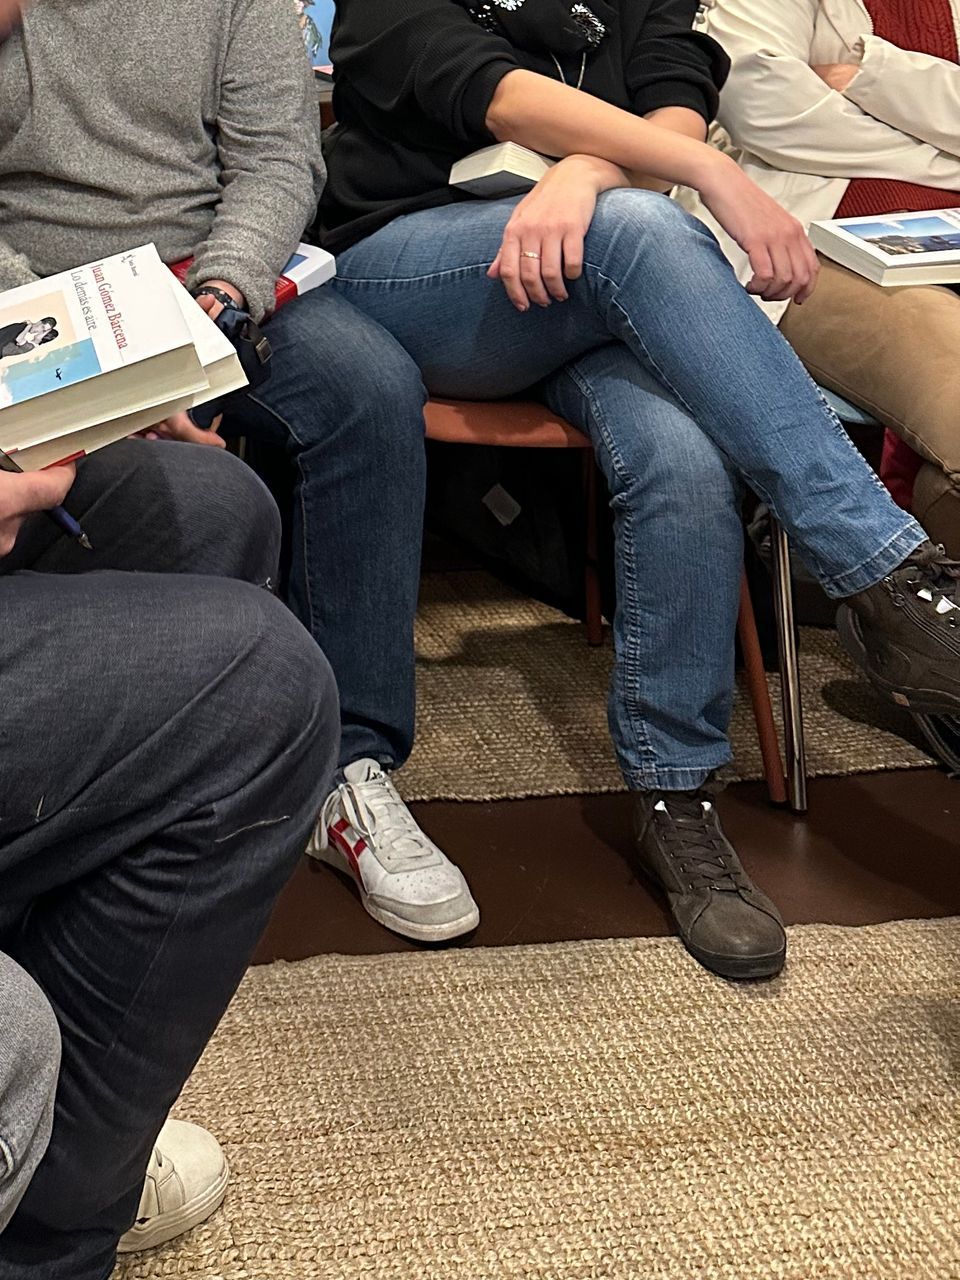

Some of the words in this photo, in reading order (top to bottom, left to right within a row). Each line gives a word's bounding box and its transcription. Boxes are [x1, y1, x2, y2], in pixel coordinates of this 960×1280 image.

[70, 270, 83, 281] Lo
[74, 282, 91, 305] demás
[82, 306, 91, 315] es
[90, 263, 104, 283] Juan
[98, 282, 115, 312] Gómez
[108, 312, 128, 349] Bárcena
[85, 315, 98, 331] aire
